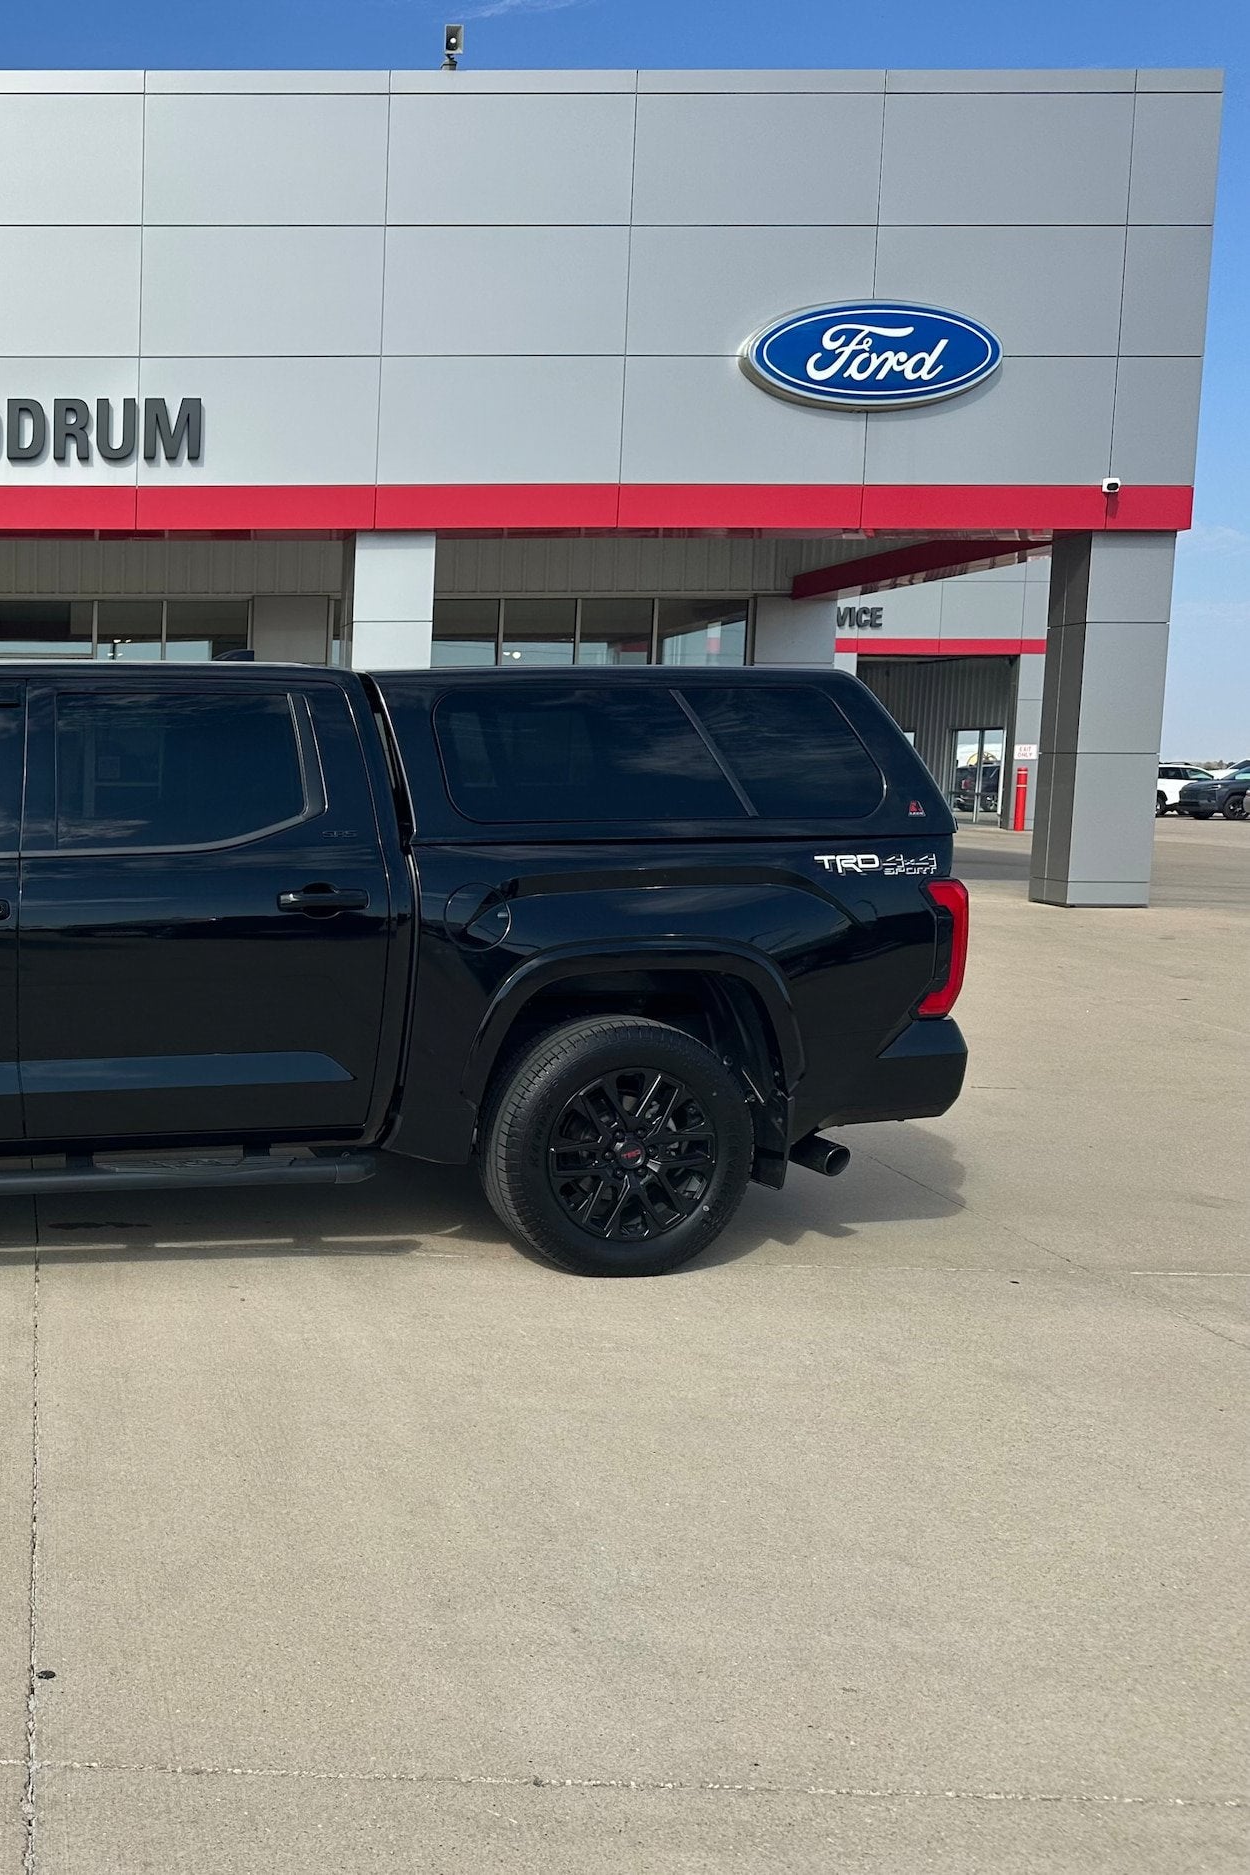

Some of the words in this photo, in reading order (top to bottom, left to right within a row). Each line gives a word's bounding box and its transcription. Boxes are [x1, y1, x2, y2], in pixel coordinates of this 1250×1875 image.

[806, 323, 949, 381] Ford
[813, 854, 881, 874] TRD
[883, 866, 937, 876] SPORT
